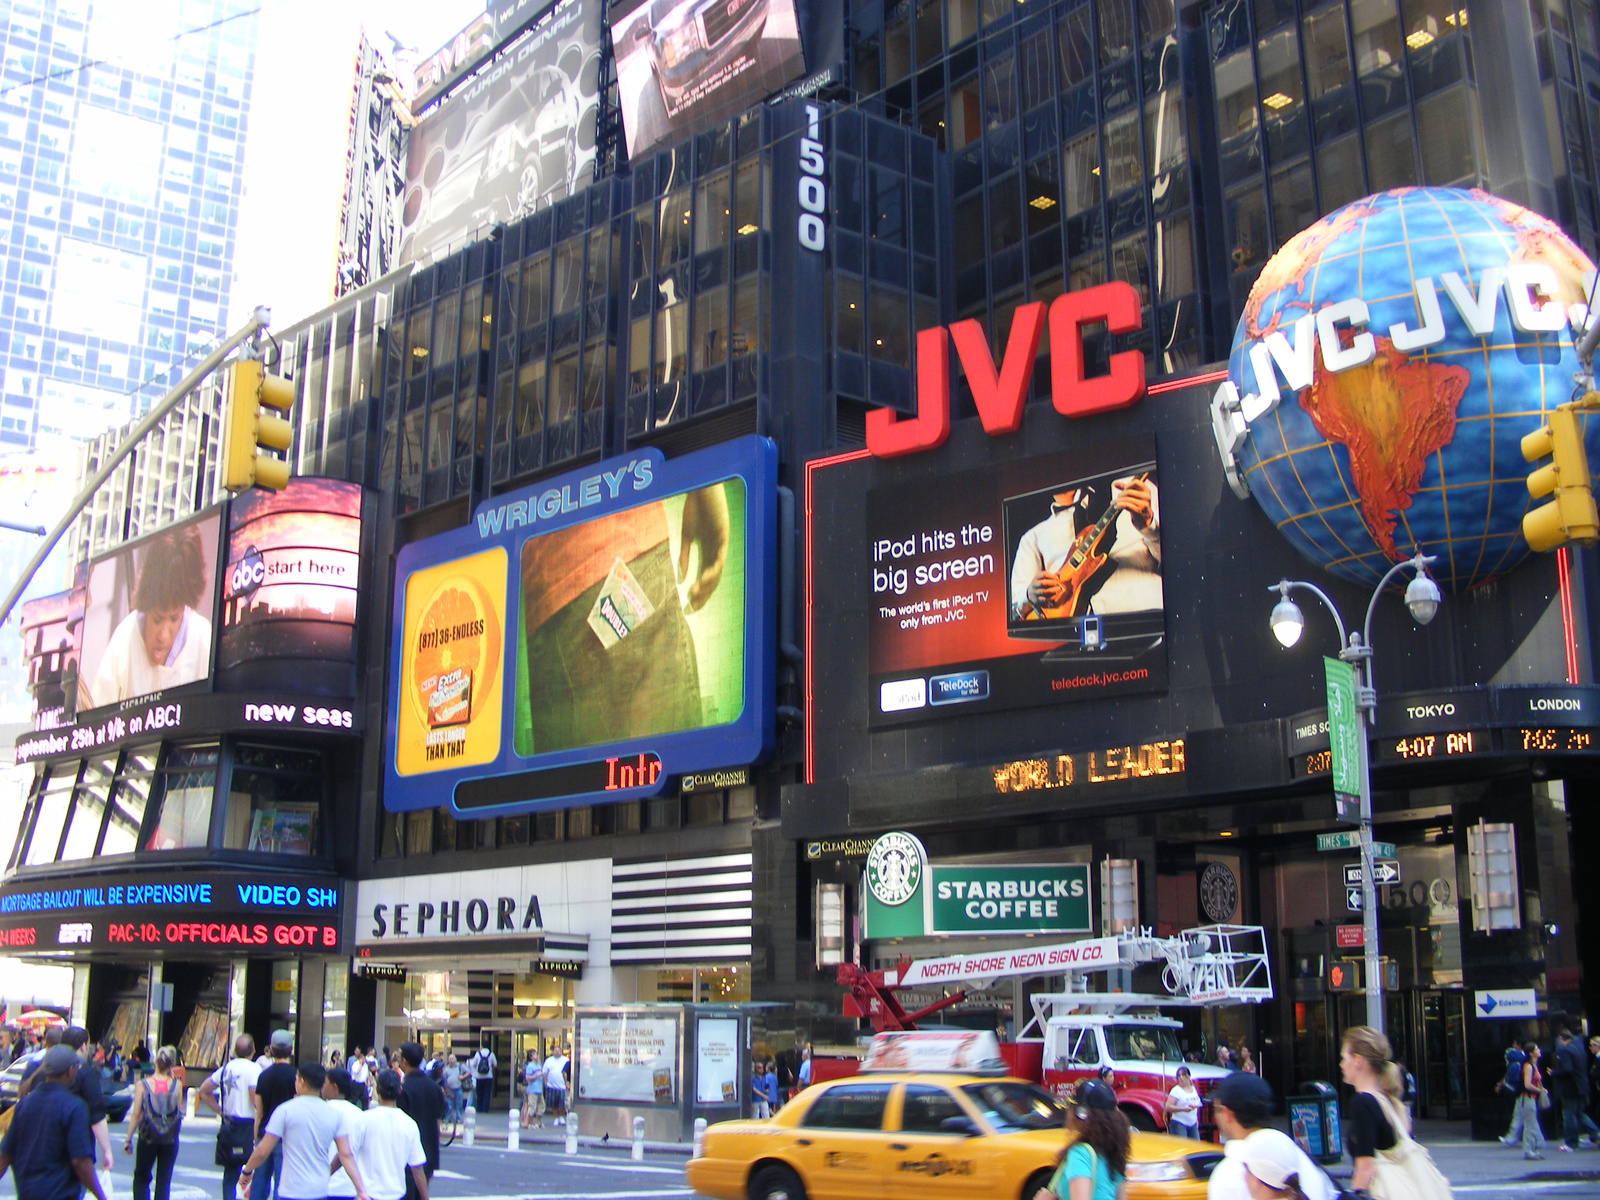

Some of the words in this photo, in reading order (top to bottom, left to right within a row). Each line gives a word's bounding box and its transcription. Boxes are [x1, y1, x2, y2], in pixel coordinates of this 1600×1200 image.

[413, 12, 494, 98] GMC
[463, 57, 514, 104] YUKON
[517, 3, 583, 63] DENALI
[799, 104, 826, 252] 1500
[1389, 264, 1568, 353] JVC
[866, 280, 1146, 460] JVC
[1240, 297, 1378, 424] JVC
[476, 459, 654, 539] WRIGLEY'S
[873, 533, 916, 562] iPod
[921, 529, 956, 554] hits
[960, 523, 993, 547] the
[232, 559, 264, 590] abc
[268, 561, 302, 576] start
[309, 559, 345, 576] here
[873, 565, 908, 595] big
[914, 553, 994, 586] screen
[879, 606, 896, 618] The
[898, 600, 931, 616] world's
[932, 597, 950, 610] first
[952, 593, 974, 606] iPod
[975, 590, 990, 602] TV
[900, 616, 920, 630] only
[921, 613, 943, 626] from
[944, 608, 967, 622] JVC.
[418, 629, 438, 653] (877)
[938, 676, 980, 693] TeleDock
[1051, 667, 1149, 691] teledock.jvc.com
[244, 702, 297, 722] new
[302, 706, 353, 729] seas
[1407, 703, 1456, 719] TOKYO
[1530, 698, 1581, 711] LONDON
[71, 726, 95, 750] 25th
[96, 724, 106, 745] at
[129, 717, 142, 735] on
[144, 703, 182, 731] ABC!
[1295, 725, 1318, 740] TIMES
[426, 744, 445, 761] THAN
[447, 740, 466, 758] THAT
[1396, 735, 1437, 759] 4:07
[1446, 731, 1473, 755] AM
[869, 835, 918, 869] STARBUCKS
[1319, 834, 1341, 849] TIMES
[1, 892, 42, 914] MORTGAGE
[43, 888, 82, 911] BAILOUT
[82, 886, 106, 908] WILL
[107, 885, 124, 905] BE
[126, 883, 213, 905] EXPENSIVE
[237, 883, 301, 907] VIDEO
[874, 880, 913, 902] COFFEE
[937, 878, 1085, 901] STARBUCKS
[372, 894, 543, 938] SEPHORA
[965, 900, 1059, 920] COFFEE
[10, 926, 36, 947] WEEKS
[108, 923, 161, 943] PAC-10:
[165, 922, 268, 945] OFFICIALS
[273, 924, 318, 946] GOT
[366, 967, 403, 976] SEPHORA
[539, 961, 579, 972] SEPHORA
[920, 960, 961, 978] NORTH
[964, 956, 1006, 974] SHORE
[1009, 953, 1046, 969] NEON
[1049, 949, 1080, 965] SIGN
[1082, 945, 1103, 961] CO.
[1498, 999, 1529, 1007] Edelman
